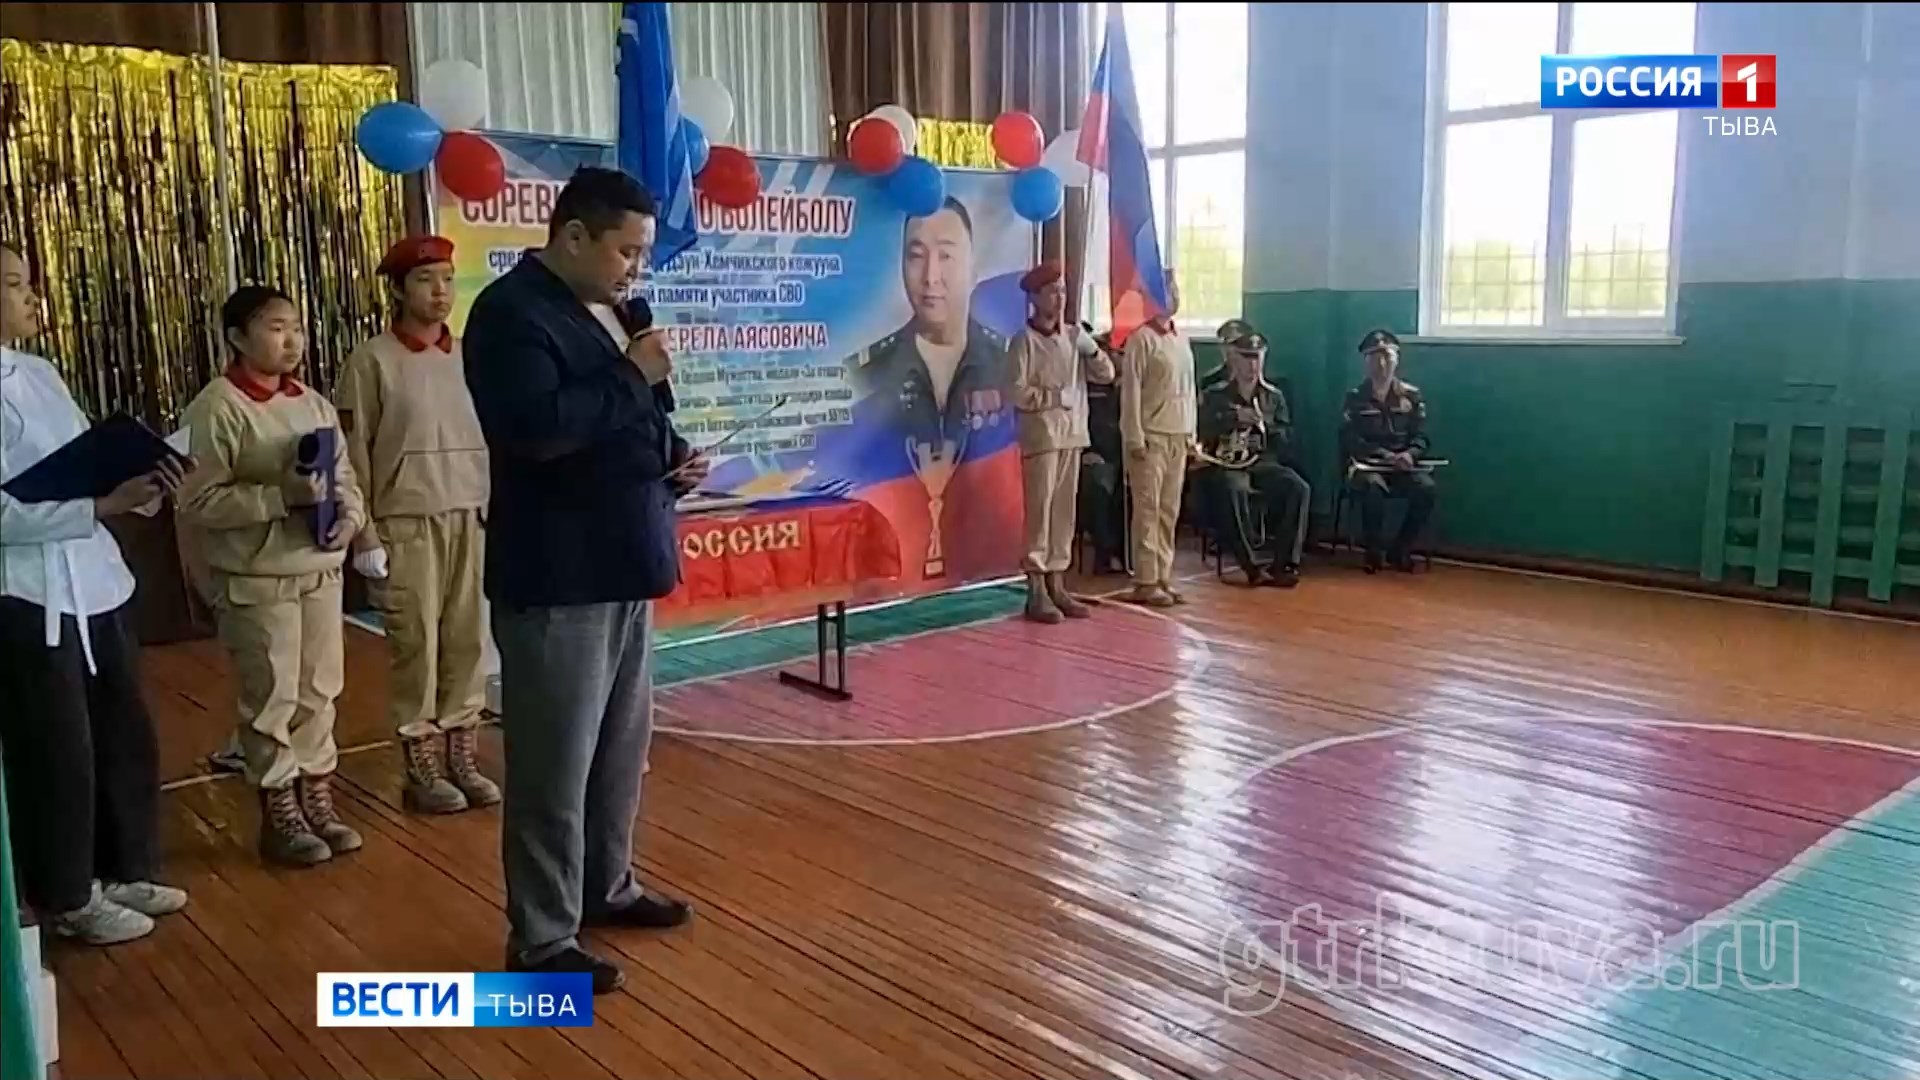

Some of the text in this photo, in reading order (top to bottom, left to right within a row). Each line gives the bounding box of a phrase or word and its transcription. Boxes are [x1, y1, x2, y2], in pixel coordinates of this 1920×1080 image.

[463, 182, 561, 223] СОРЕВ
[658, 287, 708, 304] памяти
[711, 287, 776, 309] участника
[779, 284, 802, 302] СВО
[667, 324, 827, 352] ЕРЕЛА АЯСОВИЧА
[681, 520, 800, 559] ОССИЯ
